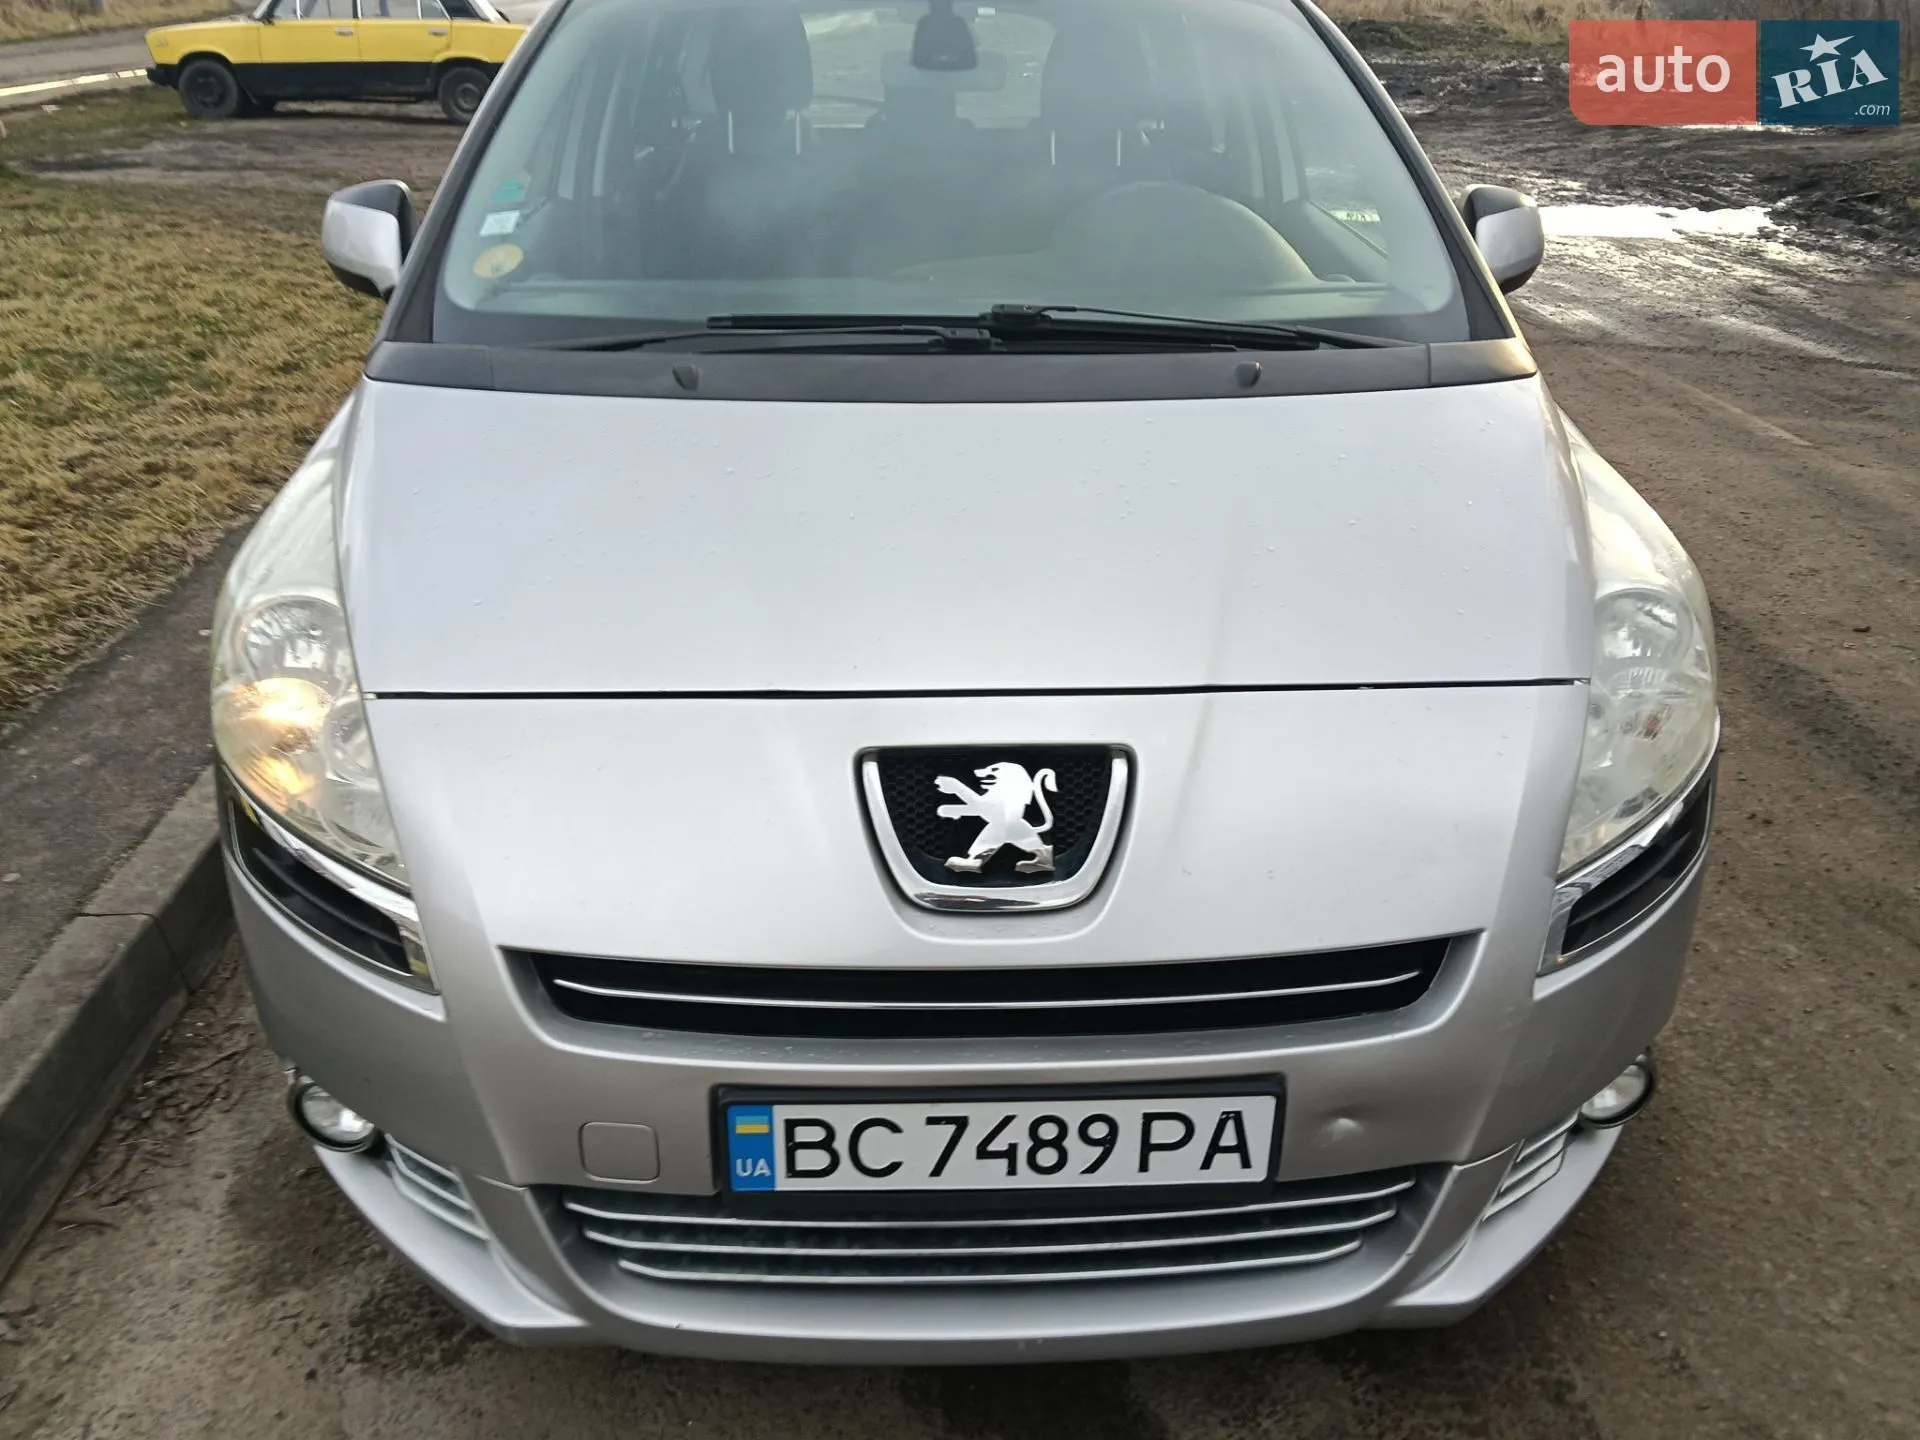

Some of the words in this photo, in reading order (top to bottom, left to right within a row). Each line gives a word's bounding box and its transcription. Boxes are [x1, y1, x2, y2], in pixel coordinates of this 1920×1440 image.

[784, 1117, 904, 1179] BC
[925, 1112, 1119, 1178] 7489
[1138, 1110, 1253, 1173] PA
[735, 1159, 771, 1178] UA
